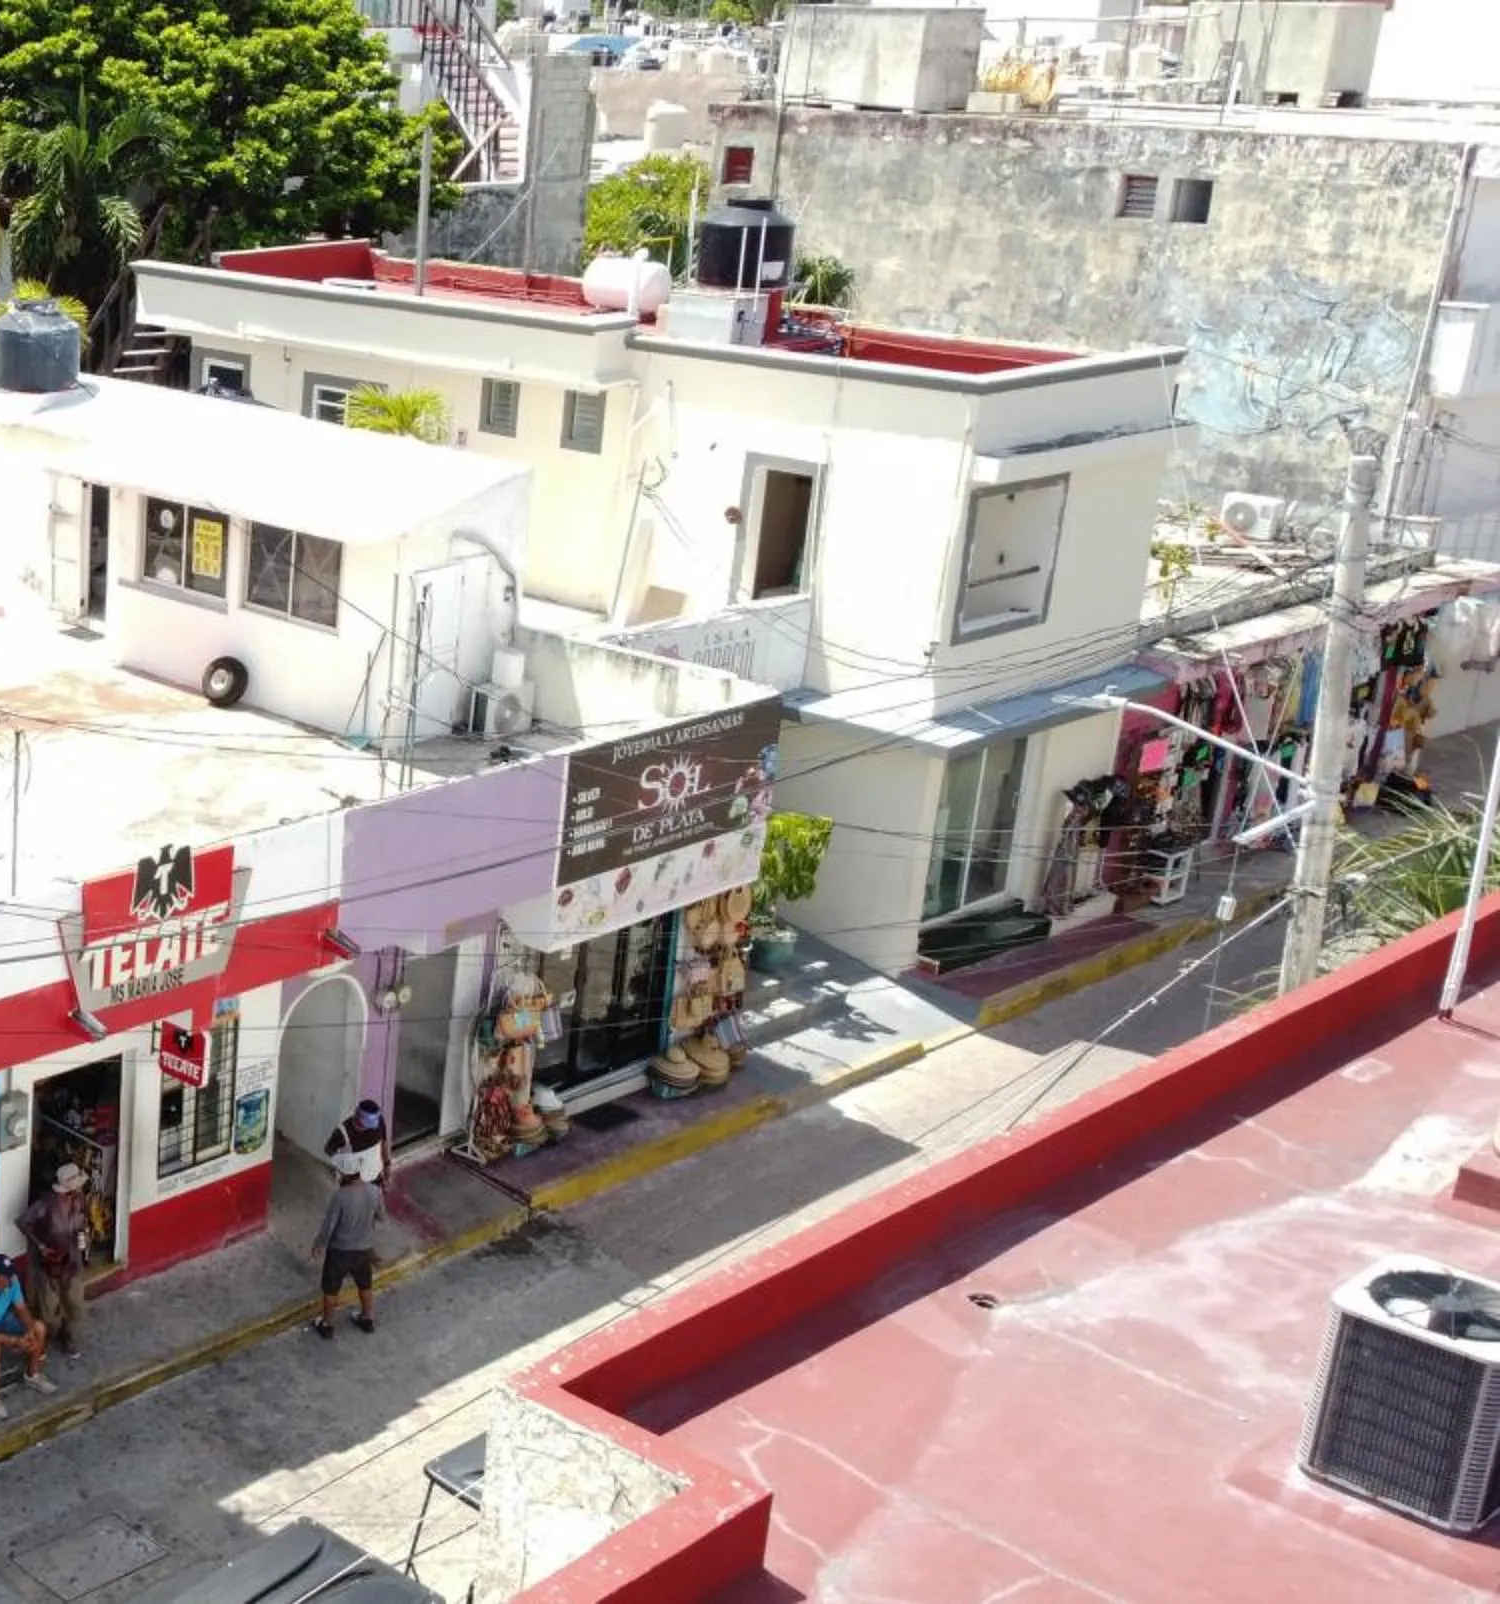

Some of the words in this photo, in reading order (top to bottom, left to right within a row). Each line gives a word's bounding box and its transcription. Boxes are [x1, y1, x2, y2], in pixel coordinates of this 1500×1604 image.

[676, 711, 745, 744] ARTESANIAS
[637, 754, 712, 811] SOL
[632, 822, 654, 844] DE
[658, 807, 706, 836] PLATA
[153, 862, 174, 895] T
[77, 900, 230, 992] TECATE
[127, 973, 157, 1000] MARIA
[159, 967, 185, 992] JOSE
[161, 1051, 201, 1082] TECATE
